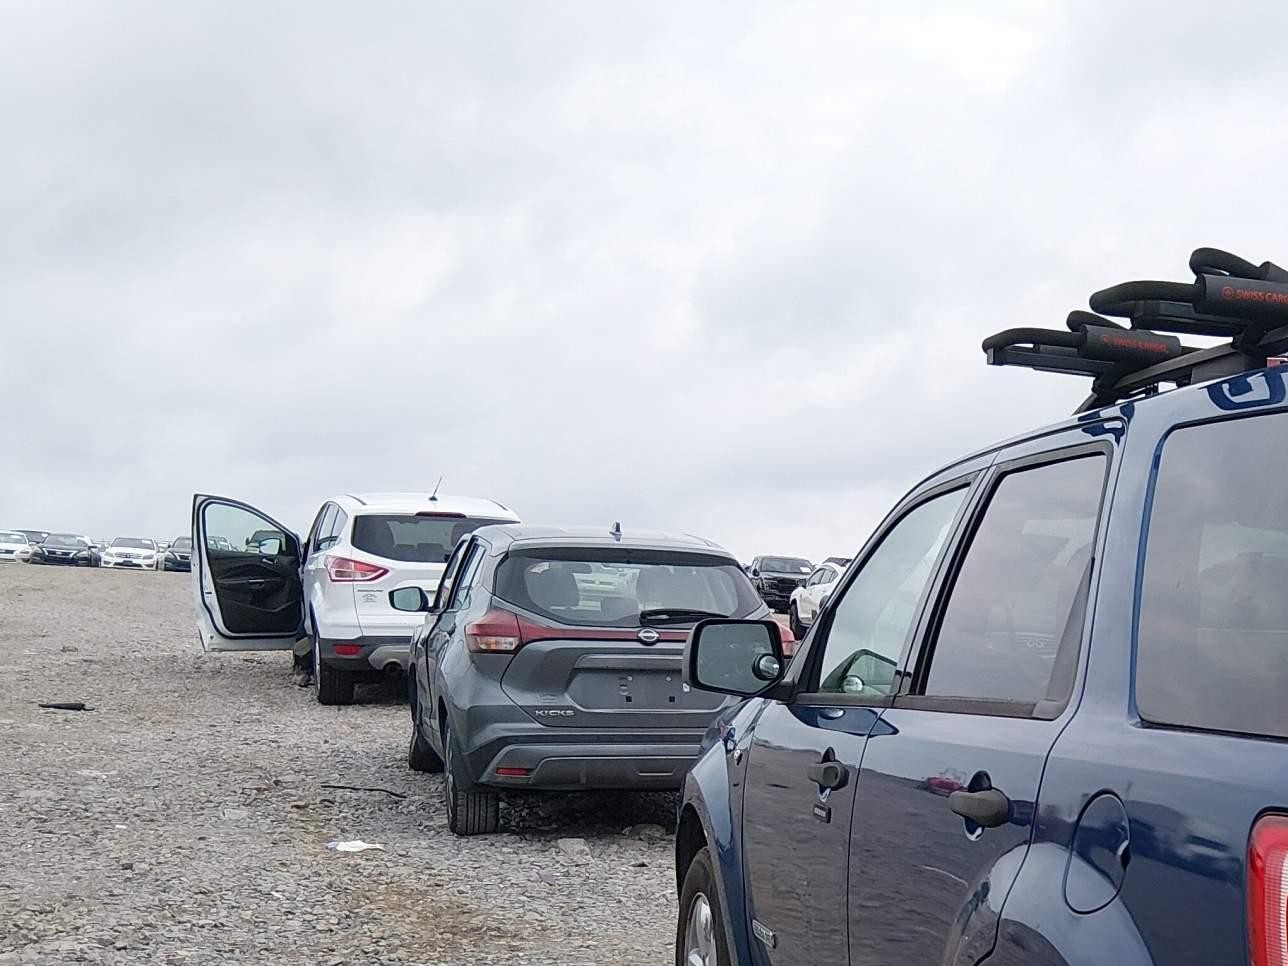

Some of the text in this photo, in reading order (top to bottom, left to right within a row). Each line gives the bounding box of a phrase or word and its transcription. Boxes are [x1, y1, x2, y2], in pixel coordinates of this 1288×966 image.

[1235, 289, 1265, 300] SWISS
[1112, 337, 1167, 352] SWISS CARGO
[535, 709, 575, 717] KICKS
